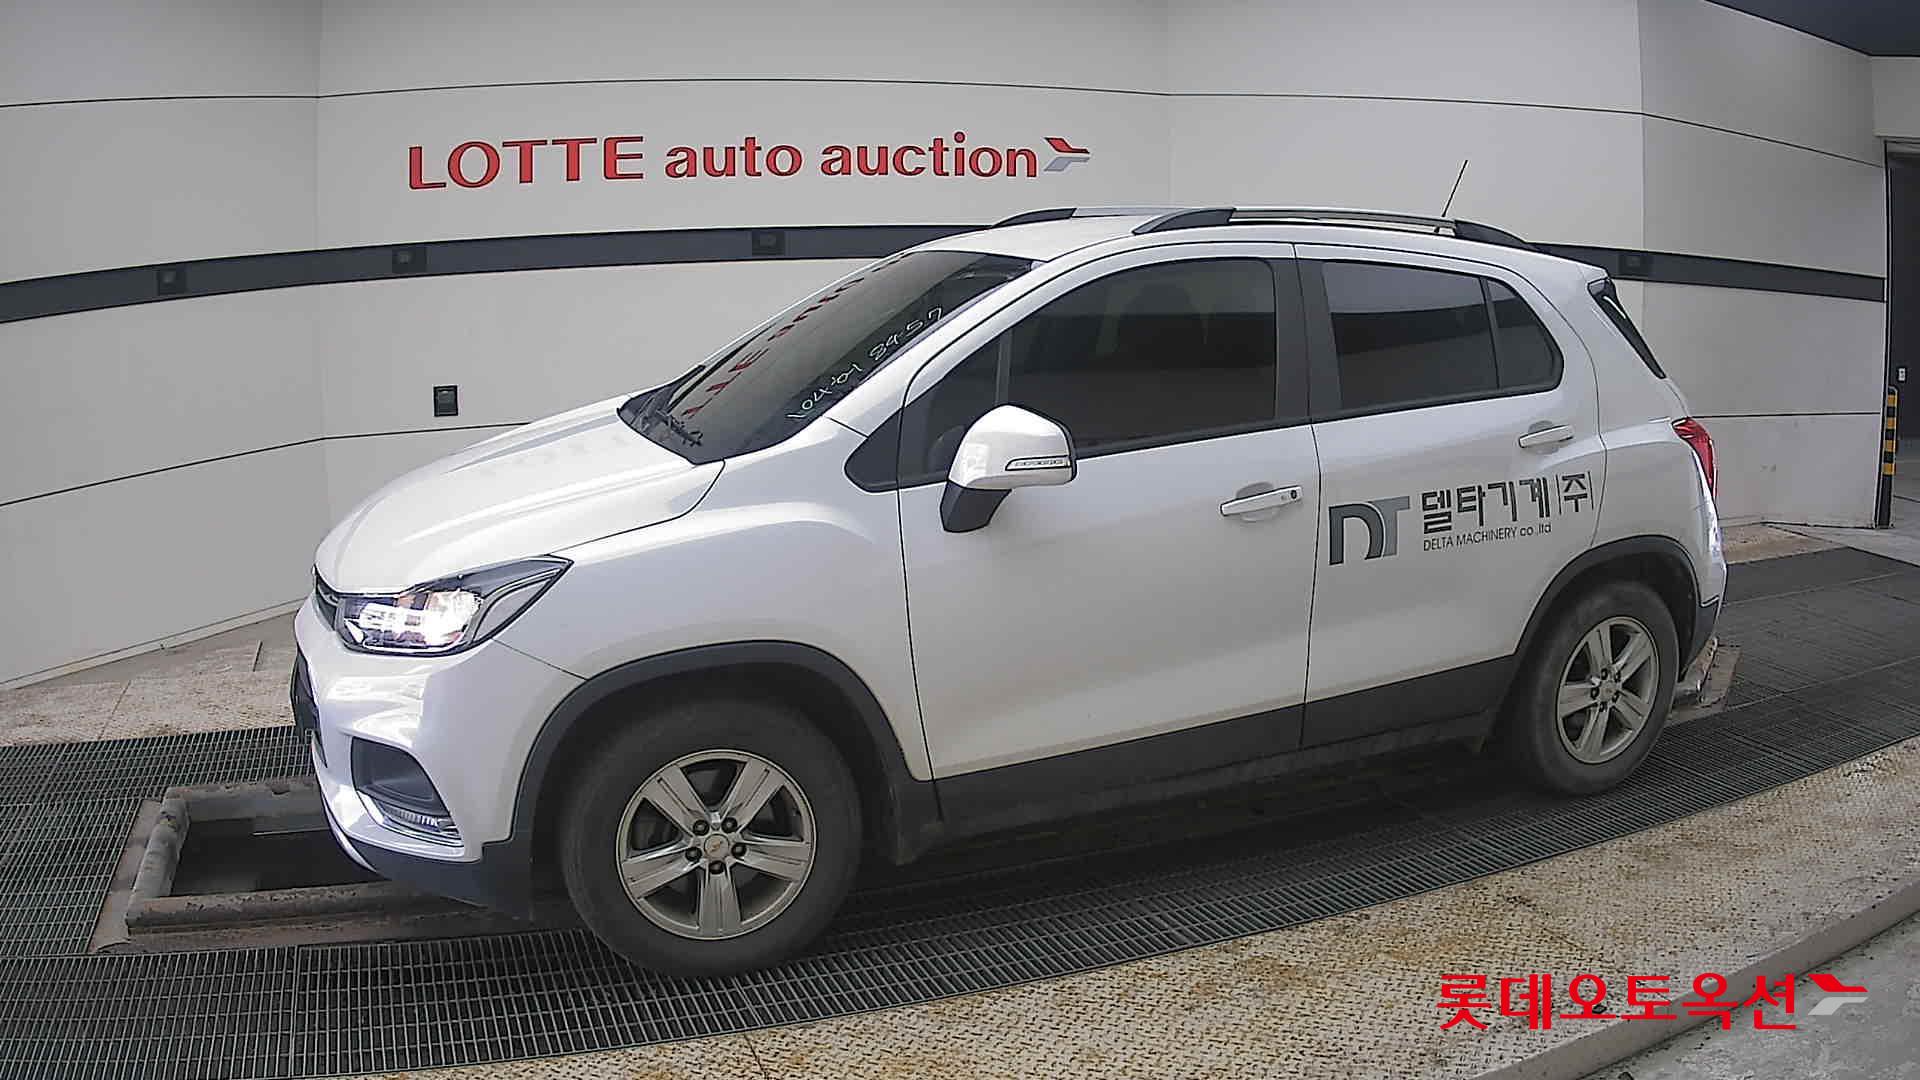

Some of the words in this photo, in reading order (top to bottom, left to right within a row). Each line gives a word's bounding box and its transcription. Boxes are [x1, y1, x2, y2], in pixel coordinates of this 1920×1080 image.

[408, 136, 644, 190] LOTTE
[664, 137, 803, 178] auto
[820, 131, 1039, 178] auction
[868, 306, 943, 361] 8457
[1423, 535, 1454, 551] DELTA
[1456, 526, 1517, 547] MACHINERY
